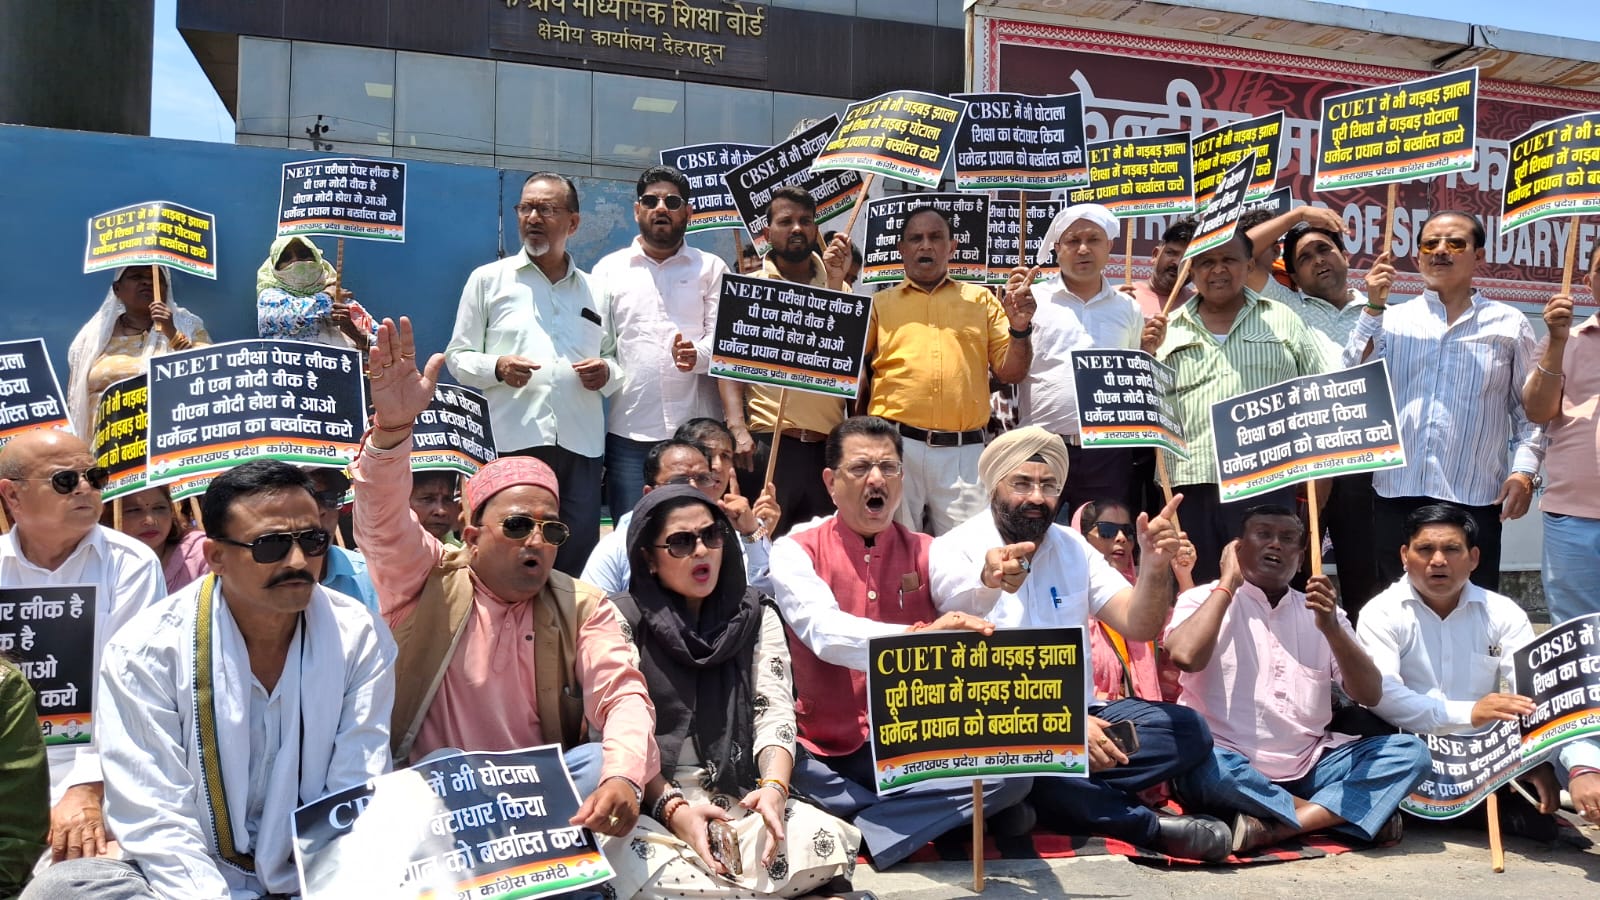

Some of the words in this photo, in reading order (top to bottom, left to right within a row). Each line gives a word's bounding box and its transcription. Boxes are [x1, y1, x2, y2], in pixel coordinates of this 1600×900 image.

[672, 2, 721, 33] शिक्षा
[726, 4, 765, 37] बोर्ड
[538, 18, 584, 45] क्षेत्रीय
[590, 26, 656, 52] कार्यालय
[968, 102, 1011, 120] CBSE
[1013, 100, 1022, 119] में
[1023, 103, 1033, 121] भी
[1034, 103, 1065, 121] घोटाला
[1328, 97, 1377, 121] CUET
[1379, 92, 1391, 111] में
[1392, 90, 1407, 109] भी
[1409, 87, 1441, 108] गड़बड़
[1443, 80, 1471, 102] झाला
[971, 124, 995, 143] शिक्षा
[997, 127, 1011, 142] का
[1040, 126, 1065, 144] किया
[1332, 122, 1348, 146] पूरी
[1350, 120, 1374, 139] शिक्षा
[1376, 115, 1388, 134] में
[1390, 114, 1422, 133] गड़बड़
[1424, 106, 1459, 126] घोटाला
[1513, 129, 1557, 161] CUET
[1560, 124, 1573, 142] में
[1575, 121, 1591, 139] भी
[1355, 142, 1383, 160] प्रधान
[1385, 136, 1401, 155] को
[1403, 130, 1440, 152] बर्खास्त
[1442, 124, 1465, 145] करो
[677, 151, 717, 171] CBSE
[740, 158, 779, 189] CBSE
[870, 201, 906, 218] NEET
[1343, 202, 1382, 256] OF
[962, 249, 979, 260] करो
[725, 281, 776, 300] NEET
[778, 289, 805, 306] परीक्षा
[807, 293, 826, 309] पेपर
[829, 298, 853, 314] लीक
[856, 300, 864, 316] है
[155, 353, 222, 382] NEET
[227, 348, 268, 367] परीक्षा
[272, 347, 301, 365] पेपर
[305, 350, 337, 369] लीक
[341, 354, 351, 373] है
[751, 344, 779, 360] प्रधान
[781, 350, 795, 363] का
[797, 351, 831, 368] बर्खास्त
[832, 356, 853, 372] करो
[1076, 356, 1125, 369] NEET
[190, 377, 205, 395] पी
[208, 376, 232, 393] एम
[235, 370, 268, 388] मोदी
[272, 368, 302, 387] वीक
[307, 371, 318, 389] है
[1104, 372, 1115, 386] पी
[29, 395, 60, 417] करो
[172, 403, 209, 421] पीएम
[213, 393, 246, 414] मोदी
[249, 391, 277, 409] होश
[281, 391, 295, 409] मे
[300, 395, 336, 413] आओ
[1093, 389, 1121, 404] पीएम
[1122, 389, 1145, 403] मोदी
[1231, 392, 1286, 423] CBSE
[1287, 386, 1301, 405] में
[1303, 383, 1320, 401] भी
[1323, 378, 1366, 399] घोटाला
[202, 421, 241, 440] प्रधान
[245, 417, 267, 433] का
[270, 414, 321, 434] बर्खास्त
[326, 419, 353, 437] करो
[1236, 426, 1266, 447] शिक्षा
[1267, 418, 1286, 437] का
[1332, 402, 1367, 423] किया
[178, 449, 229, 466] उत्तराखण्ड
[233, 445, 259, 458] प्रदेश
[266, 442, 302, 455] कांग्रेस
[306, 444, 336, 457] कमेटी
[1259, 443, 1292, 467] प्रधान
[1293, 432, 1313, 454] को
[1315, 426, 1363, 450] बर्खास्त
[1364, 420, 1392, 442] करो
[20, 595, 65, 620] लीक
[70, 593, 84, 619] है
[20, 625, 36, 651] है
[1528, 630, 1576, 670] CBSE
[1579, 623, 1594, 645] में
[878, 645, 947, 675] CUET
[951, 642, 966, 669] में
[970, 640, 988, 668] भी
[992, 646, 1035, 670] गड़बड़
[1039, 644, 1076, 669] झाला
[1533, 673, 1558, 695] शिक्षा
[1559, 661, 1577, 680] का
[40, 683, 78, 707] करो
[885, 680, 908, 717] पूरी
[911, 679, 945, 706] शिक्षा
[949, 676, 964, 703] में
[967, 681, 1011, 705] गड़बड़
[1013, 673, 1062, 700] घोटाला
[1551, 688, 1585, 715] प्रधान
[921, 717, 960, 741] प्रधान
[964, 709, 984, 736] को
[988, 706, 1039, 735] बर्खास्त
[1042, 706, 1072, 733] करो
[451, 763, 476, 792] भी
[478, 760, 540, 785] घोटाला
[903, 758, 949, 775] उत्तराखण्ड
[953, 756, 978, 768] प्रदेश
[985, 753, 1019, 766] कांग्रेस
[1023, 750, 1053, 764] कमेटी
[1447, 763, 1468, 776] का
[497, 792, 547, 820] किया
[443, 840, 475, 873] को
[477, 827, 548, 864] बर्खास्त
[480, 876, 527, 896] कांग्रेस
[531, 864, 570, 882] कमेटी
